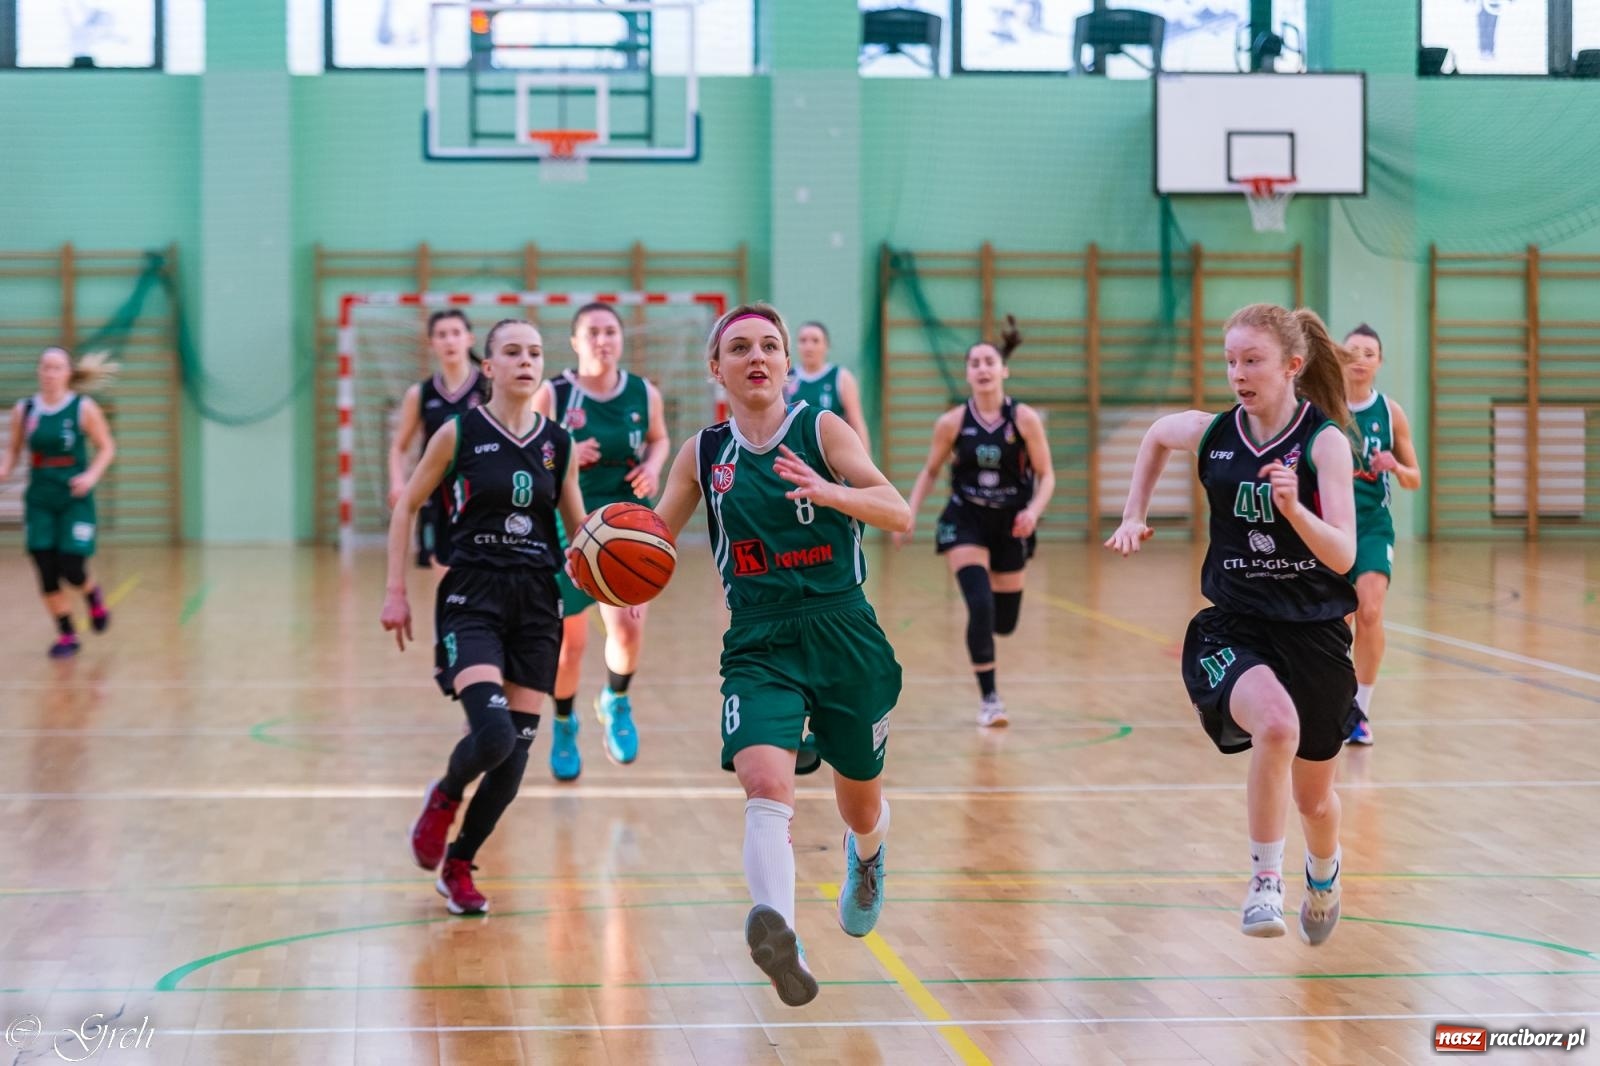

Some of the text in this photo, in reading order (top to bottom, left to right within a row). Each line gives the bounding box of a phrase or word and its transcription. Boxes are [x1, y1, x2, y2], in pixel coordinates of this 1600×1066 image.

[511, 470, 533, 508] 8
[794, 486, 815, 525] 8
[1233, 481, 1275, 523] 41
[734, 543, 764, 573] K
[1223, 558, 1248, 570] CTL
[725, 694, 741, 736] 8
